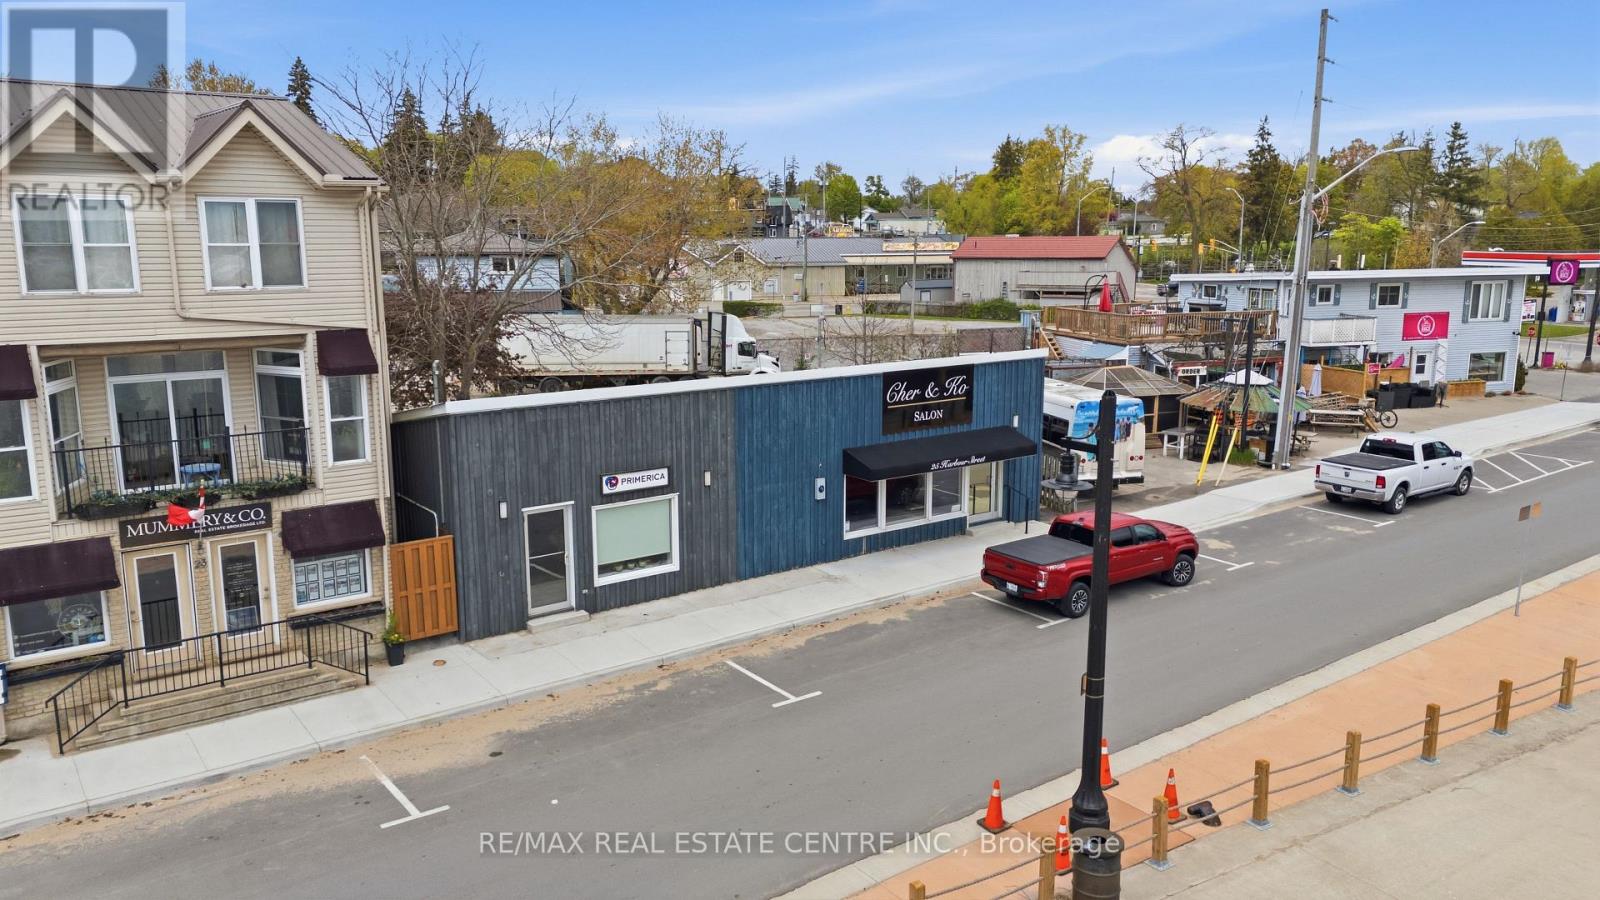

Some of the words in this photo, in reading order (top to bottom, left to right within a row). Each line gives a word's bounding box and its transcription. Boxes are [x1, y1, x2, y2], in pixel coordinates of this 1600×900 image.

[886, 381, 921, 403] Cher
[925, 381, 940, 398] &
[944, 375, 970, 396] Ko
[914, 409, 943, 421] SALON
[940, 458, 970, 468] Harbour
[621, 473, 665, 485] PRIMERICA
